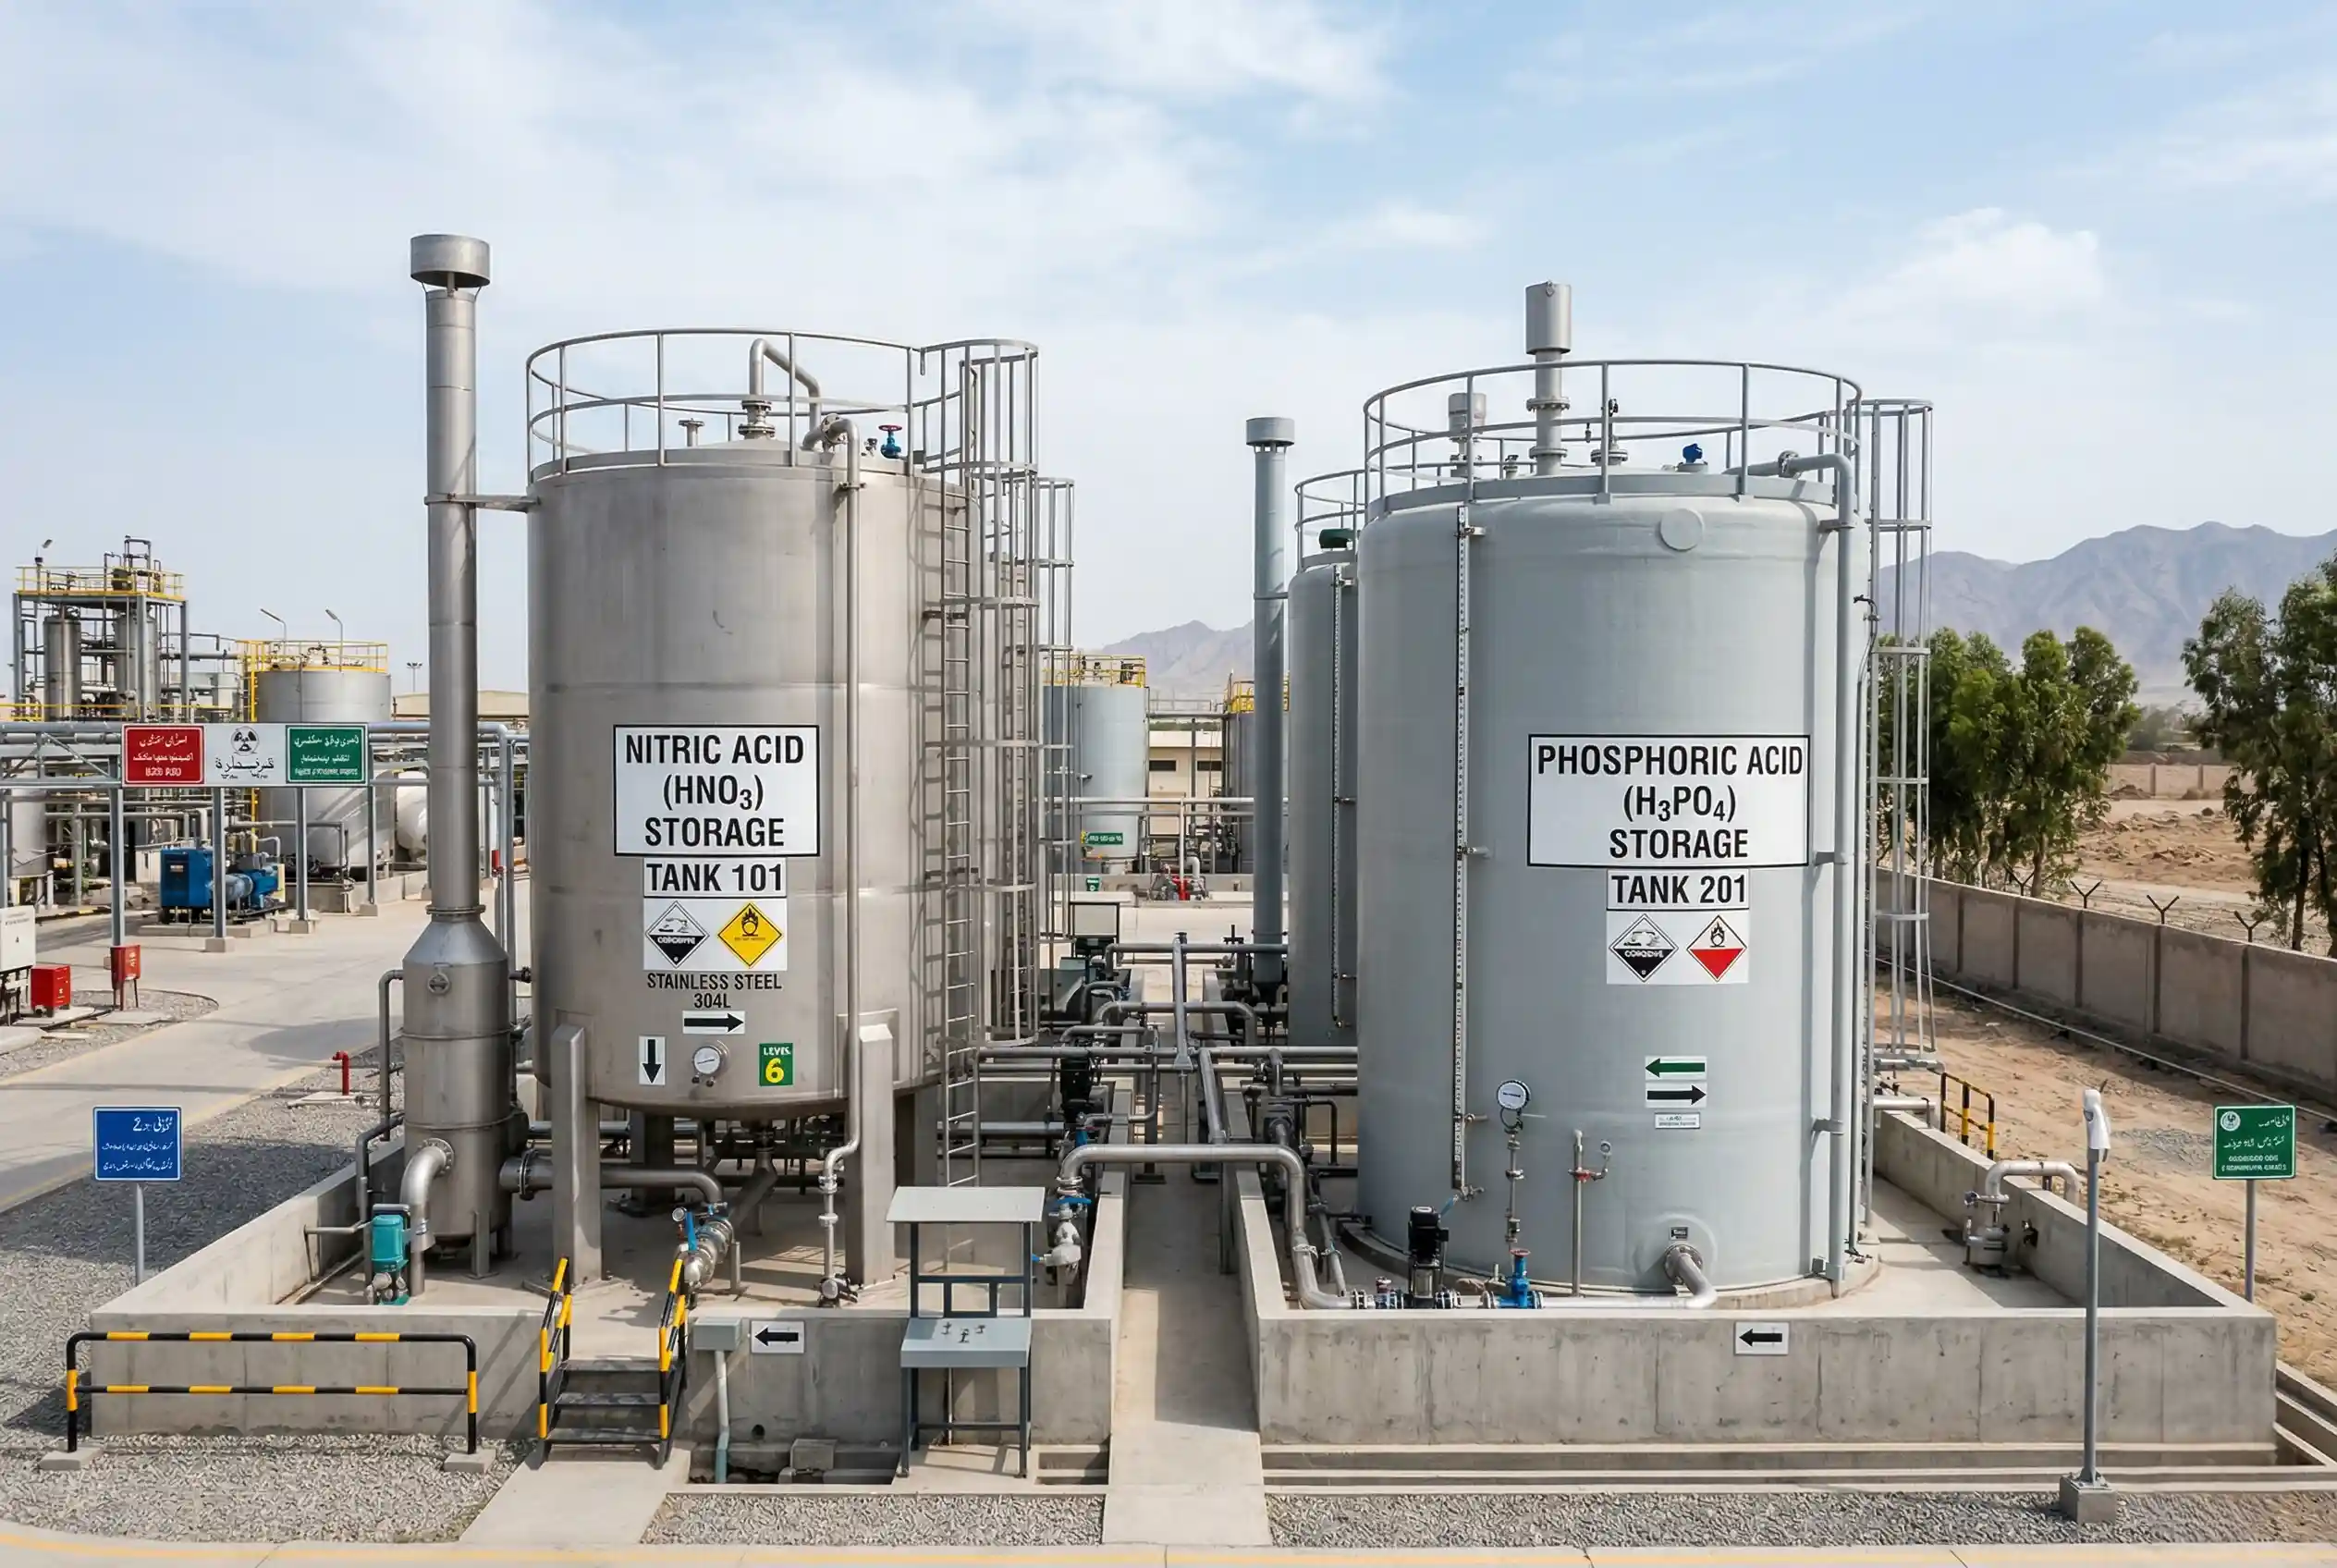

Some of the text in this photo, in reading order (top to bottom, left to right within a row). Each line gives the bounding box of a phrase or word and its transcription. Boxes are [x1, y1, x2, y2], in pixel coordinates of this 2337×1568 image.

[626, 734, 803, 765] NITRIC ACID
[1537, 744, 1803, 776] PHOSPHORIC ACID
[644, 816, 785, 847] STORAGE
[1609, 828, 1748, 859] STORAGE
[645, 863, 781, 892] TANK 101
[1610, 874, 1745, 904] TANK 201
[646, 973, 782, 990] STAINLESS STEEL
[693, 992, 732, 1009] 304L
[765, 1057, 785, 1084] 6
